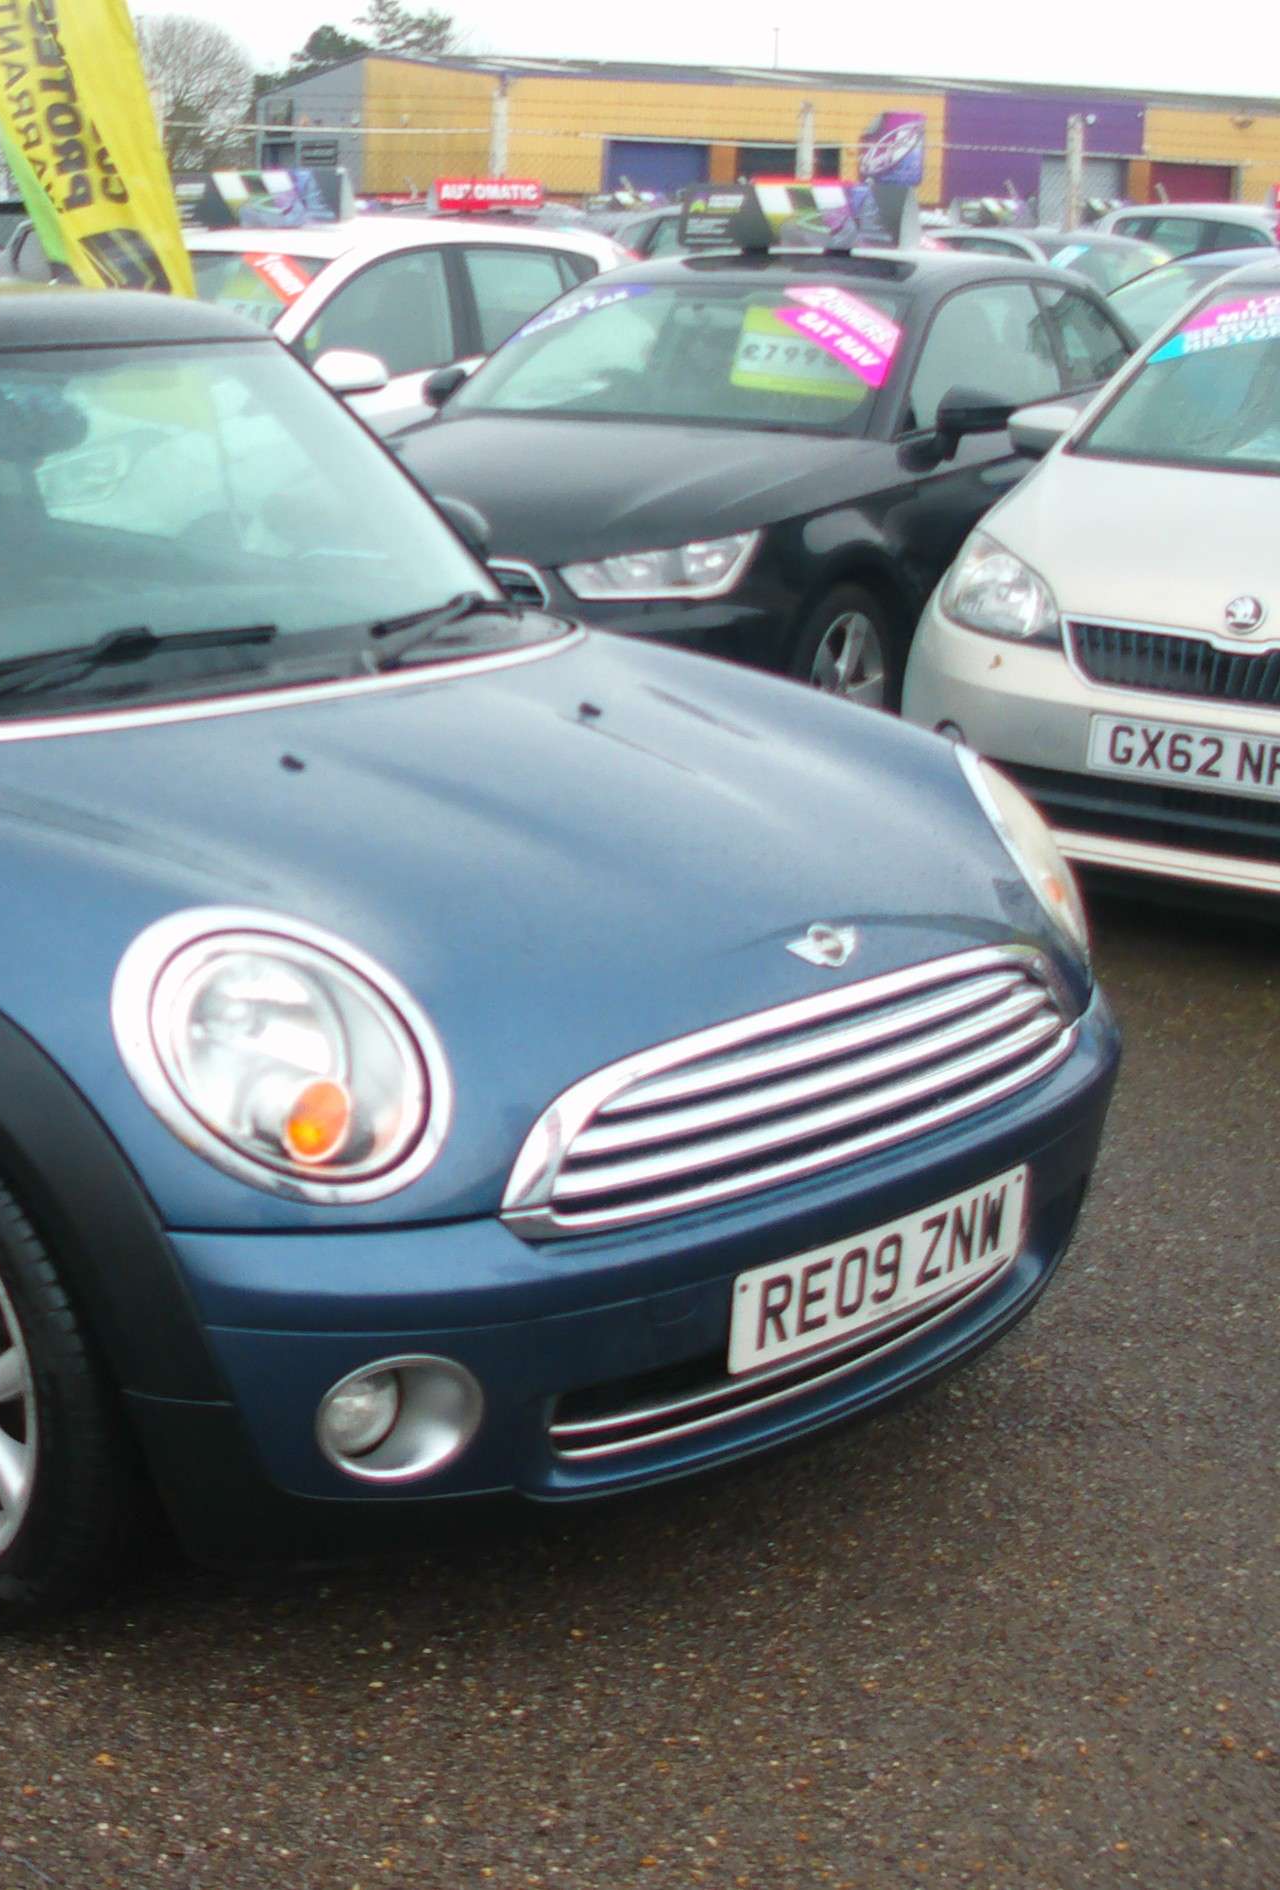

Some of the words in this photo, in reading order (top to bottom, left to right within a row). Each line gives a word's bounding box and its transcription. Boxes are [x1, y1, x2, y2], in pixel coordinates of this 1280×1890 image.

[441, 182, 538, 201] AUTOMATIC
[1109, 725, 1224, 778] GX62
[756, 1235, 904, 1351] RE09
[915, 1184, 1007, 1289] ZNW
